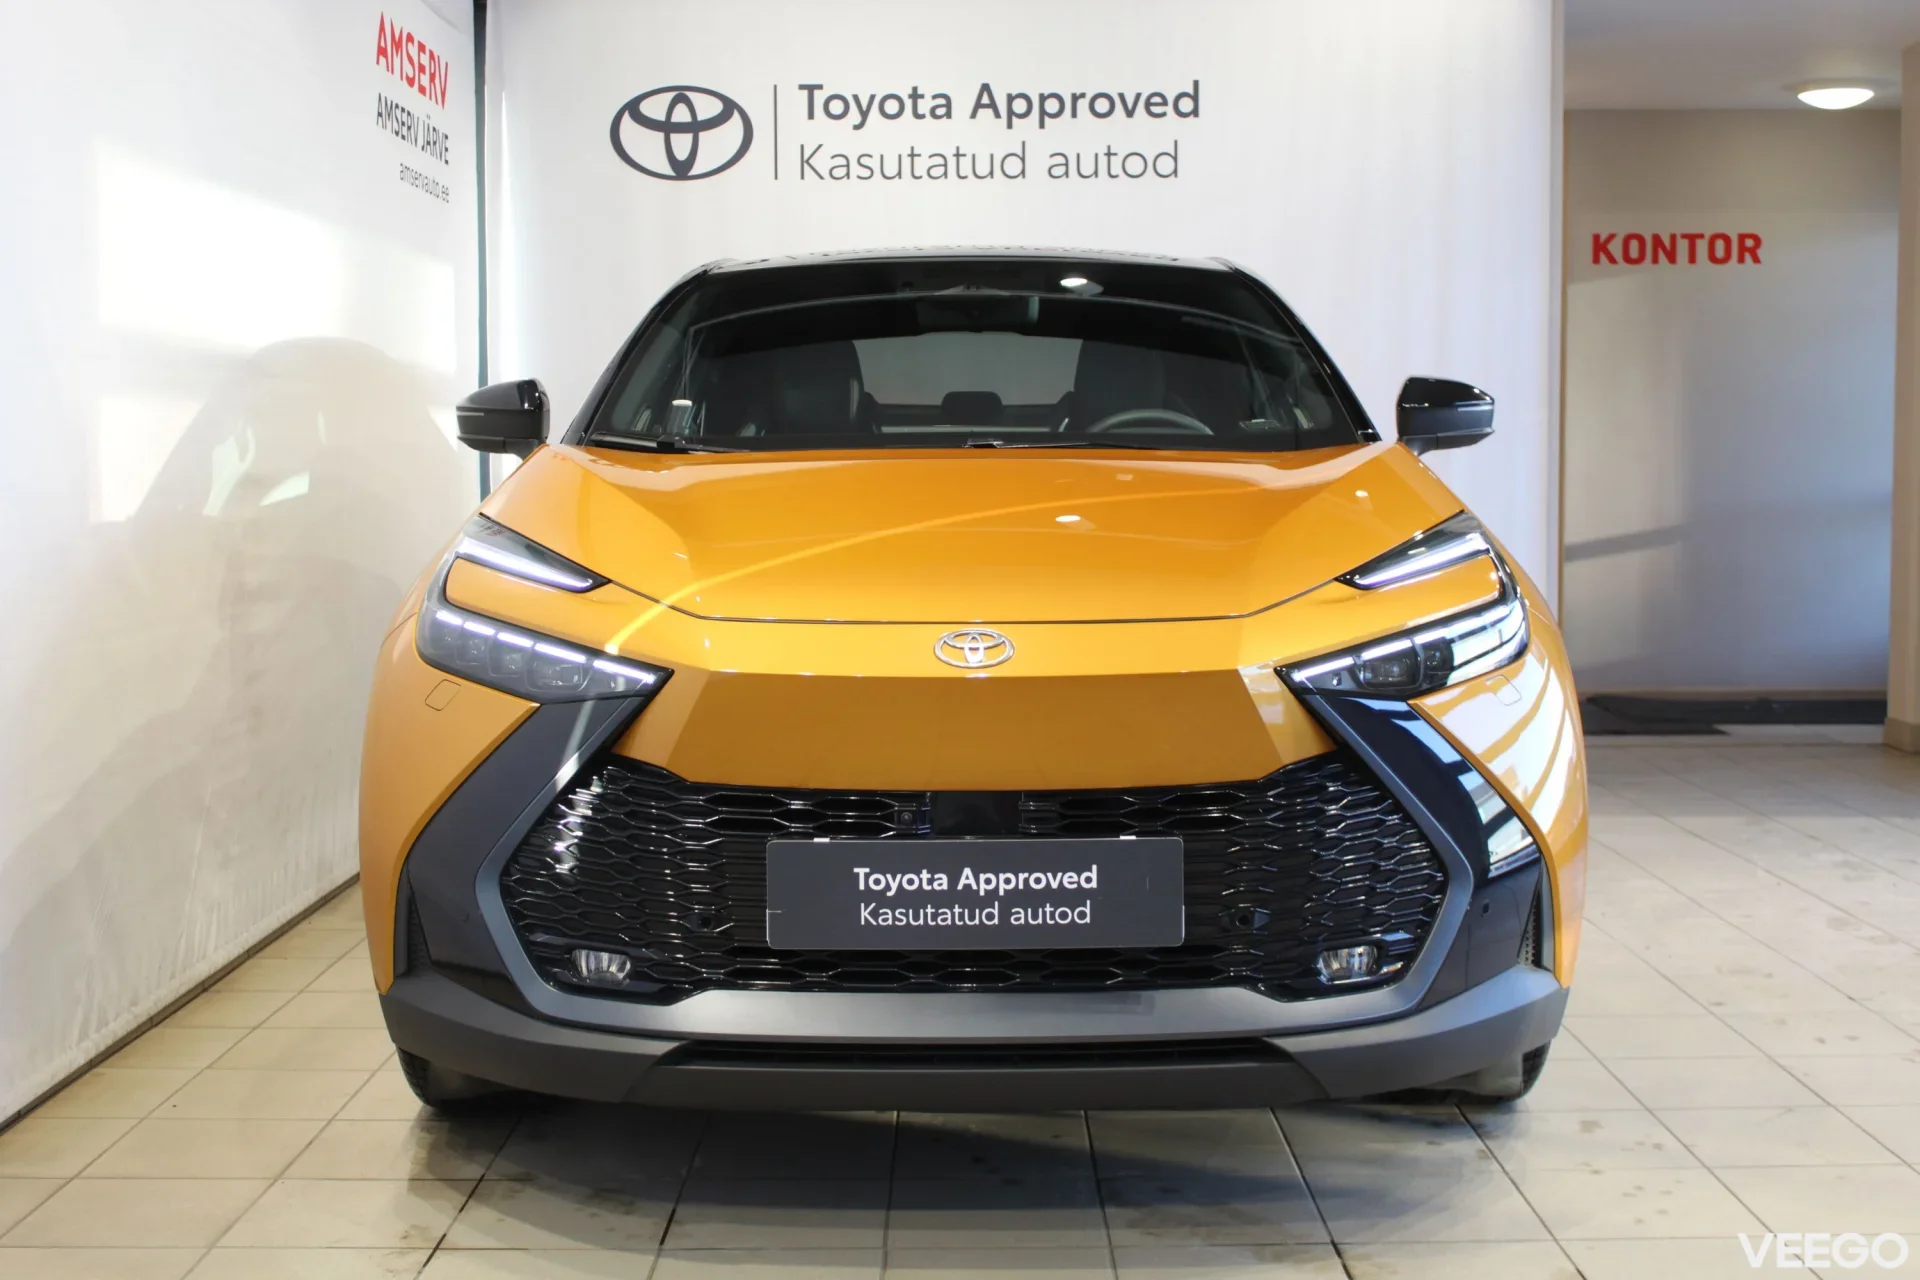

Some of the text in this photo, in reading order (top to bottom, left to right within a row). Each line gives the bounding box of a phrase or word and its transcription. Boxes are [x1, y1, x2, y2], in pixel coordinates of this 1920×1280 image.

[376, 11, 449, 110] AMSERV
[798, 80, 1200, 130] Toyota Approved
[376, 92, 449, 166] AMSERV JÄRVE
[800, 140, 1180, 181] Kasutatud autod
[399, 163, 450, 203] amservauto.ee
[1592, 232, 1763, 265] KONTOR
[853, 864, 1098, 896] Toyota Approved
[860, 899, 1091, 926] Kasutatud autod
